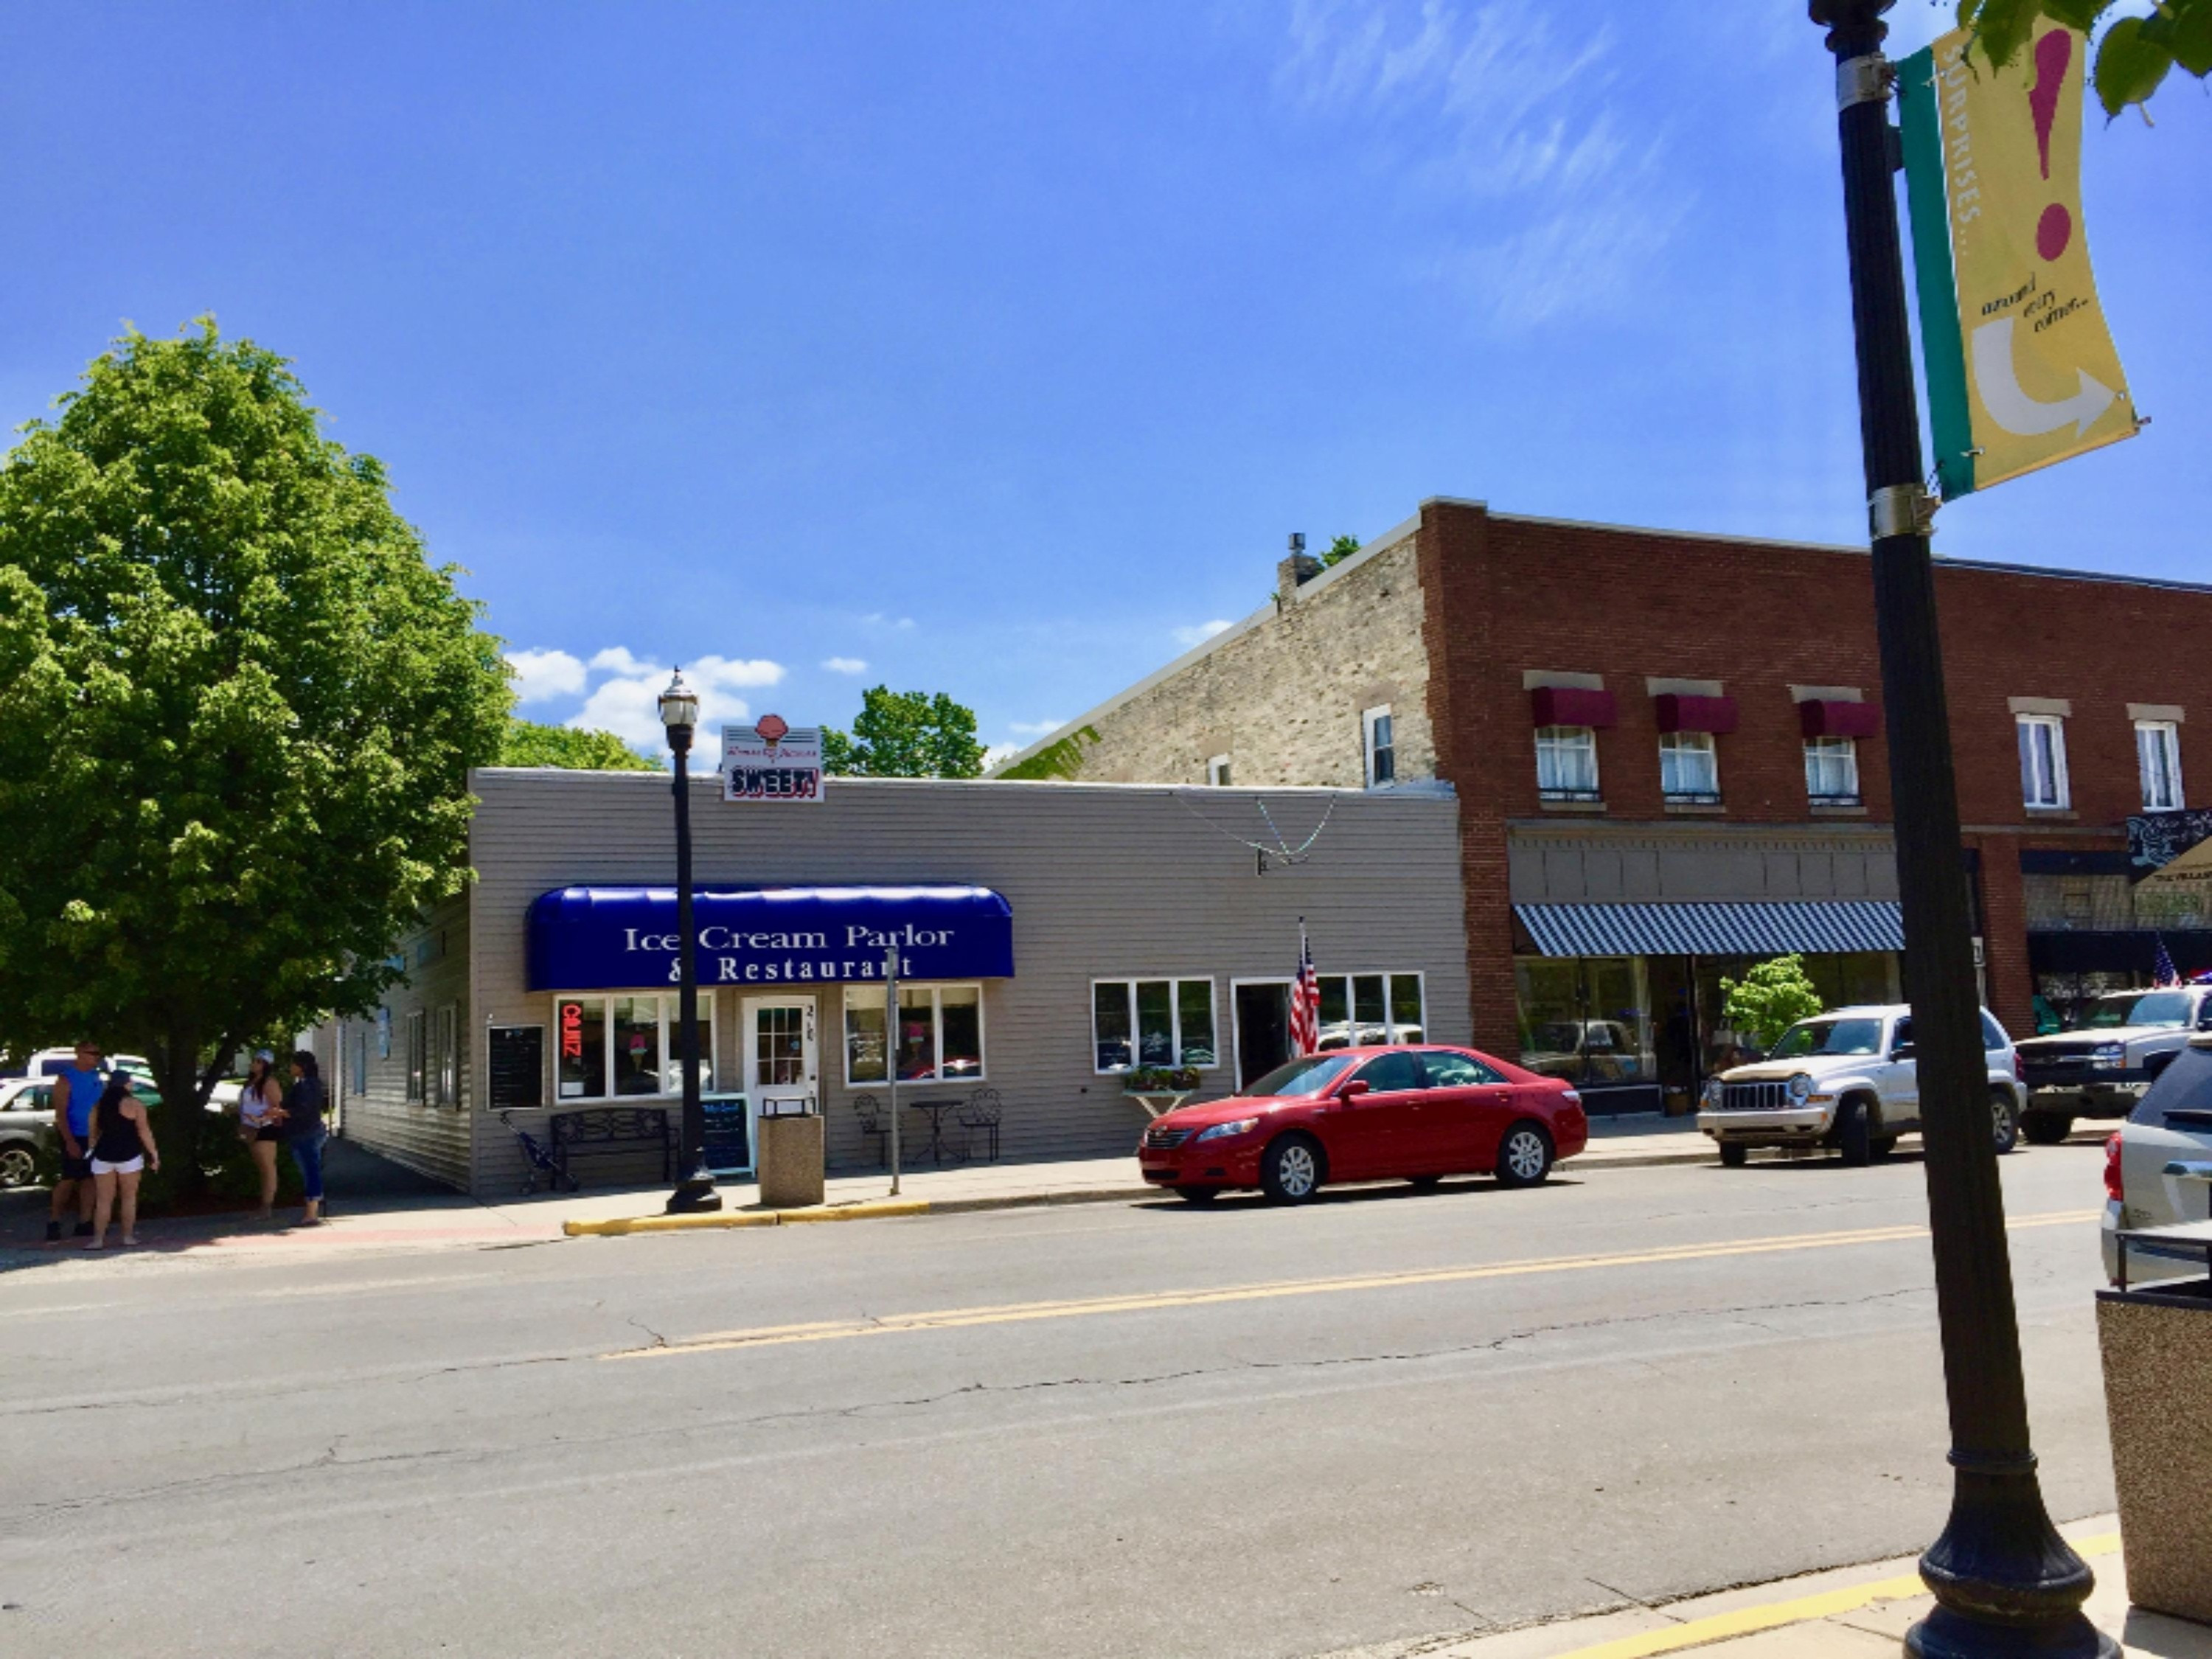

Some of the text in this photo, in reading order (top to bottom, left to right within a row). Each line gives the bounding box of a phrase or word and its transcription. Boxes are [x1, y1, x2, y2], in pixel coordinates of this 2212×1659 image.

[624, 923, 954, 951] Ice Cream Parlor
